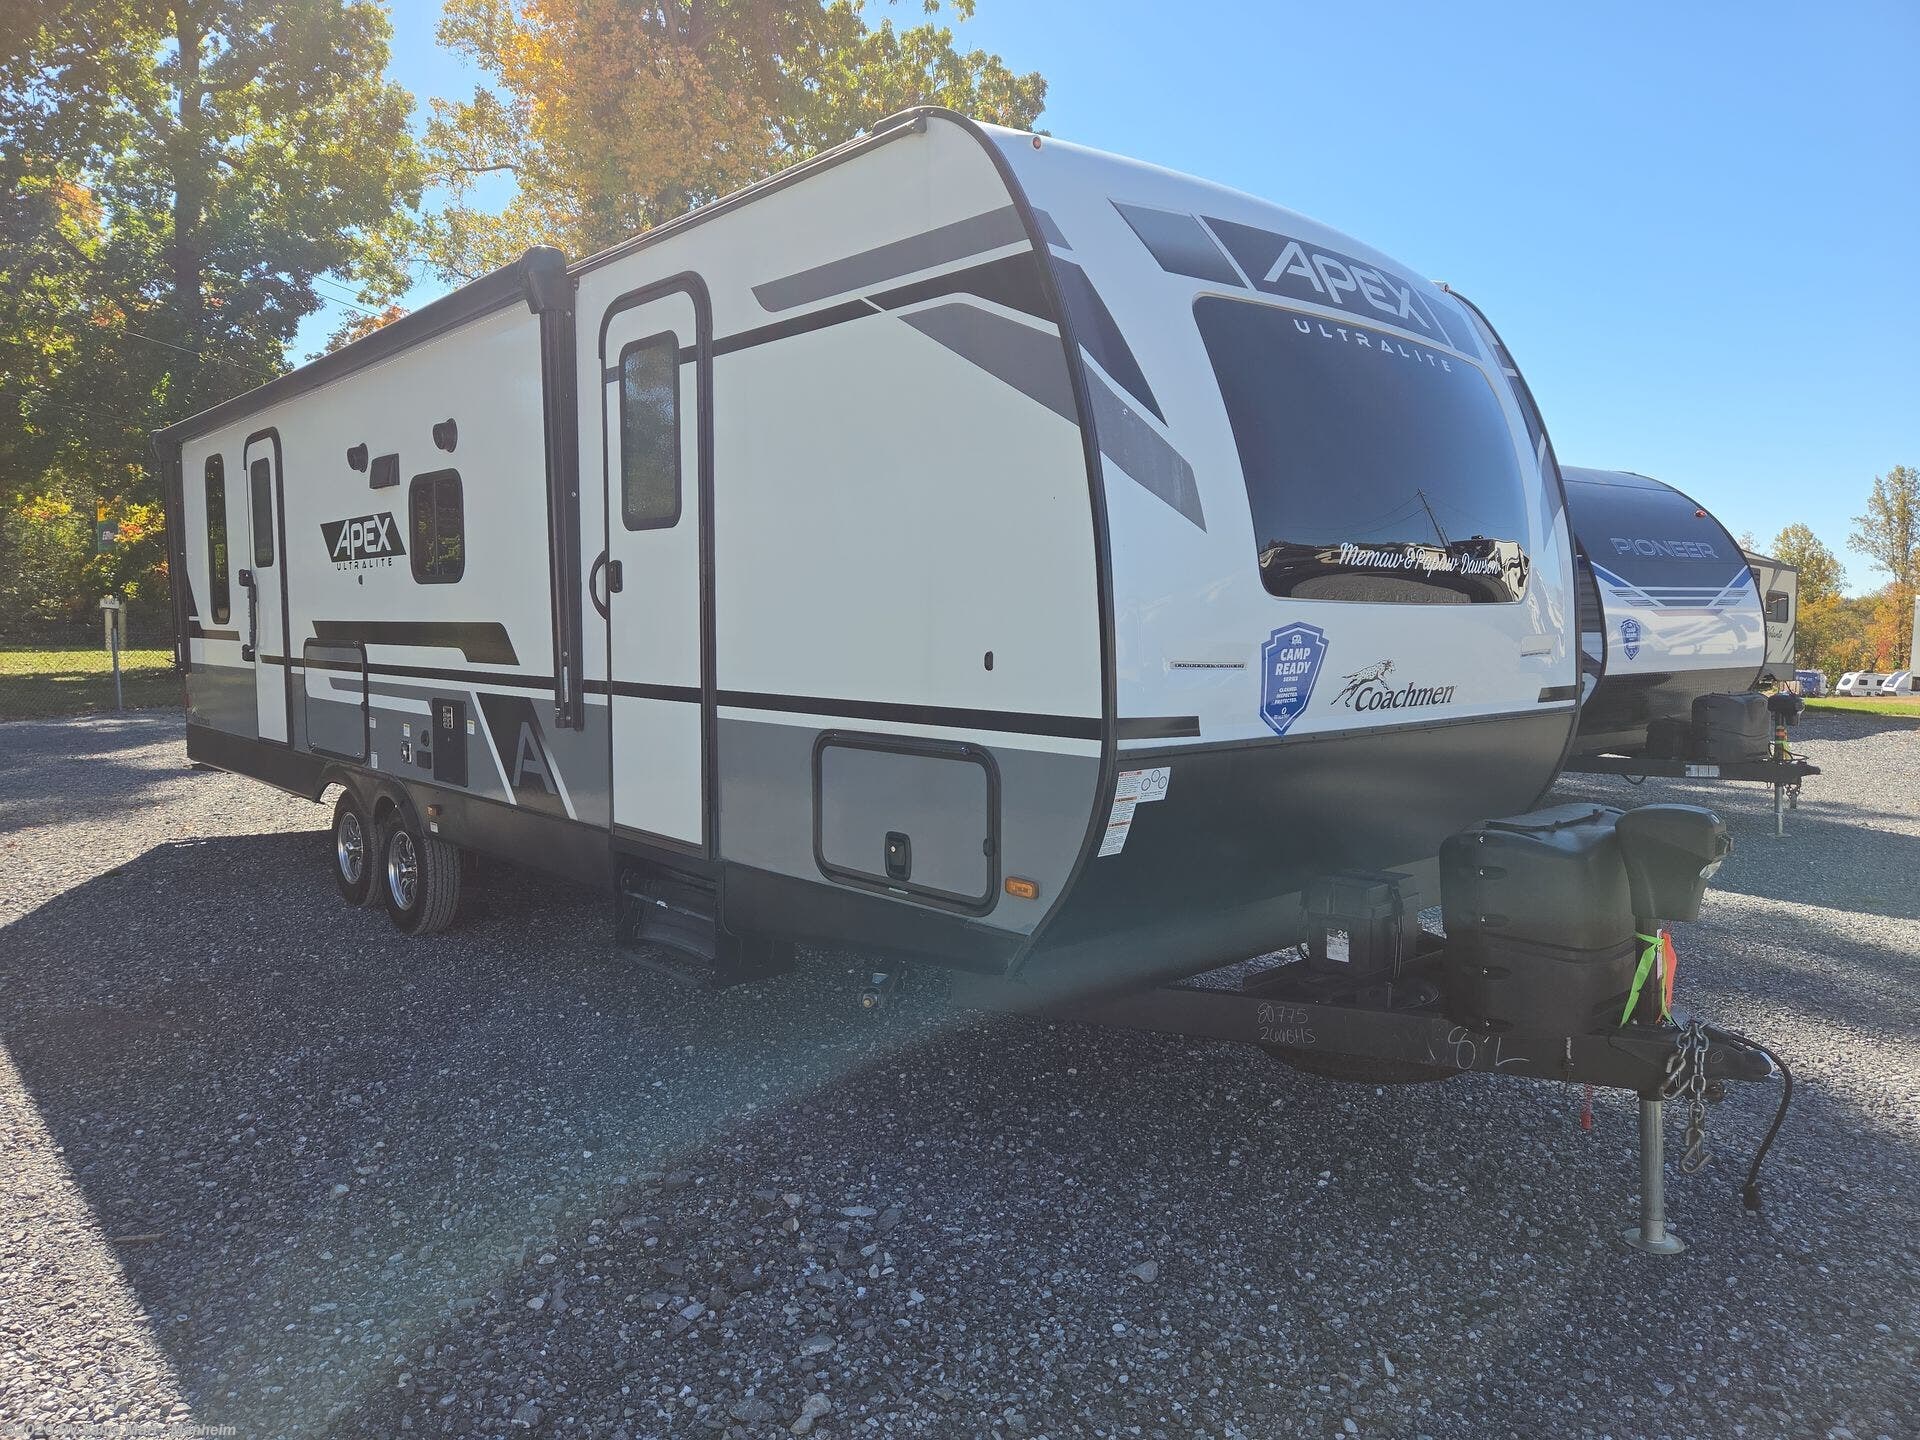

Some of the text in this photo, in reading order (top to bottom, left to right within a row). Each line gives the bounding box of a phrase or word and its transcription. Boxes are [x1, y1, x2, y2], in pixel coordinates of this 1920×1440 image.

[1263, 240, 1431, 329] APEX
[1293, 318, 1452, 373] ULTRALITE
[333, 514, 392, 560] APEX
[1608, 536, 1720, 560] PIONEER
[336, 557, 393, 571] ULTRALITE
[1338, 542, 1501, 578] Memaw & Papaw Dawson
[1275, 661, 1312, 676] READY
[1280, 647, 1311, 661] CAMP
[1354, 681, 1456, 712] Coachmen
